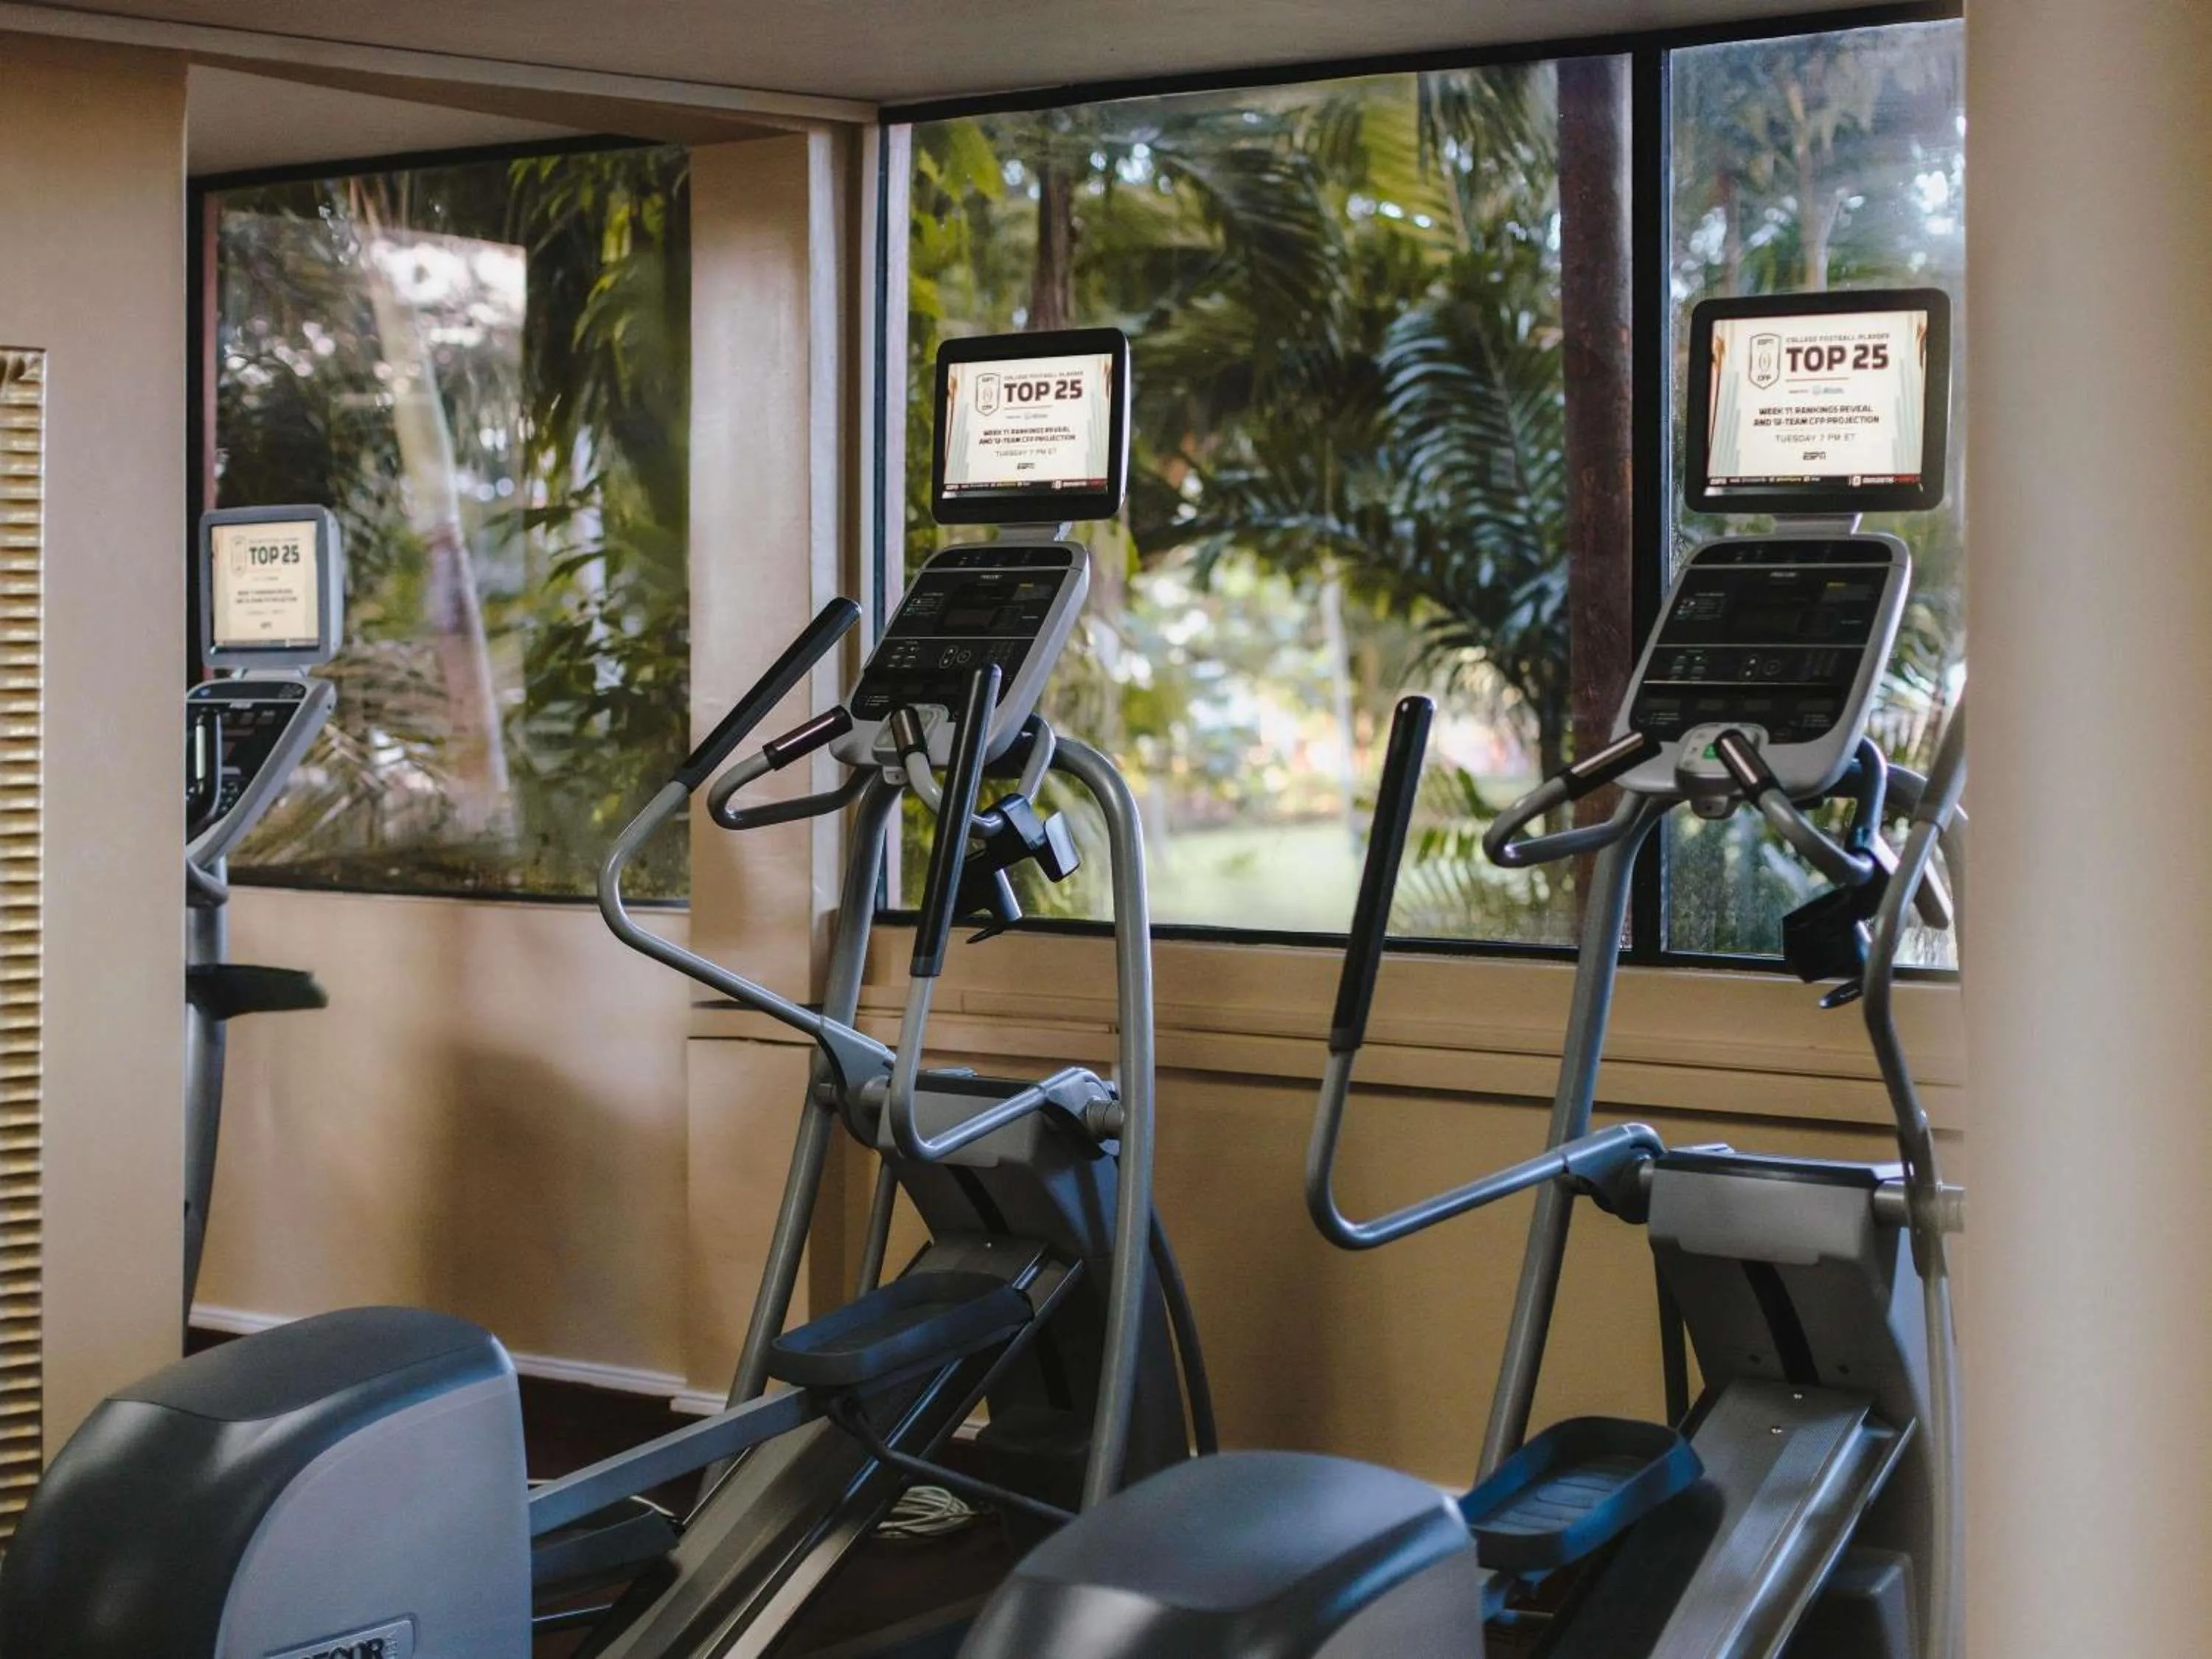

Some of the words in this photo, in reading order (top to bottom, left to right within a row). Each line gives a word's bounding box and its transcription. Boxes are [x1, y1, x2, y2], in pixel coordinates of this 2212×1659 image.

[1785, 345, 1846, 373] TOP
[1852, 343, 1890, 370] 25
[1004, 381, 1051, 403] TOP
[1054, 379, 1082, 400] 25
[1759, 408, 1782, 416] WEEK
[1795, 406, 1838, 414] RANKINGS
[1840, 404, 1873, 413] REVEAL
[1753, 418, 1771, 426] AND
[1826, 416, 1879, 424] PROJECTION
[1775, 434, 1816, 443] TUESDAY
[1803, 451, 1826, 460] ESPN
[248, 546, 279, 565] TOP
[282, 544, 300, 563] 25
